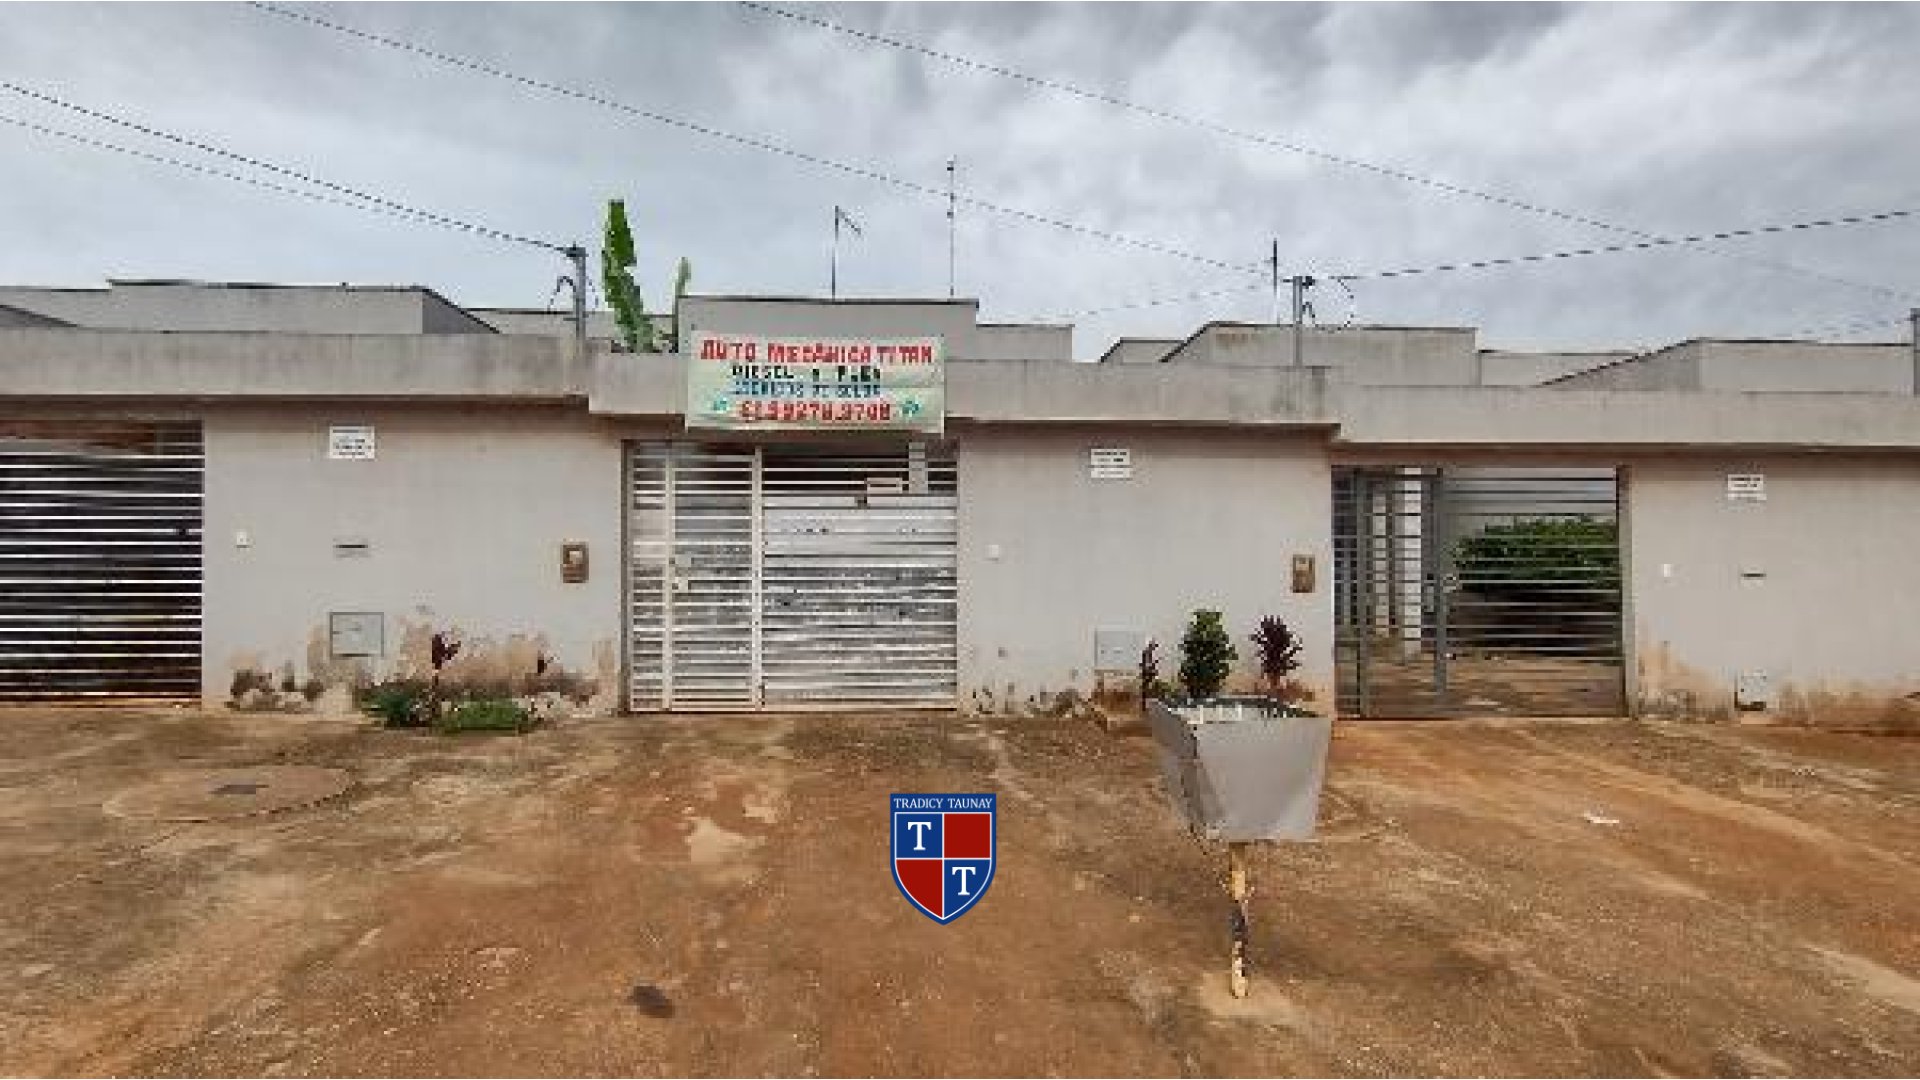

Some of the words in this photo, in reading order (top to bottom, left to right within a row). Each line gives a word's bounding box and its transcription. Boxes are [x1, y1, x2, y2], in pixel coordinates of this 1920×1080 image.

[701, 339, 756, 361] AUTO
[877, 345, 932, 363] TITAN
[732, 365, 794, 379] DIESEL
